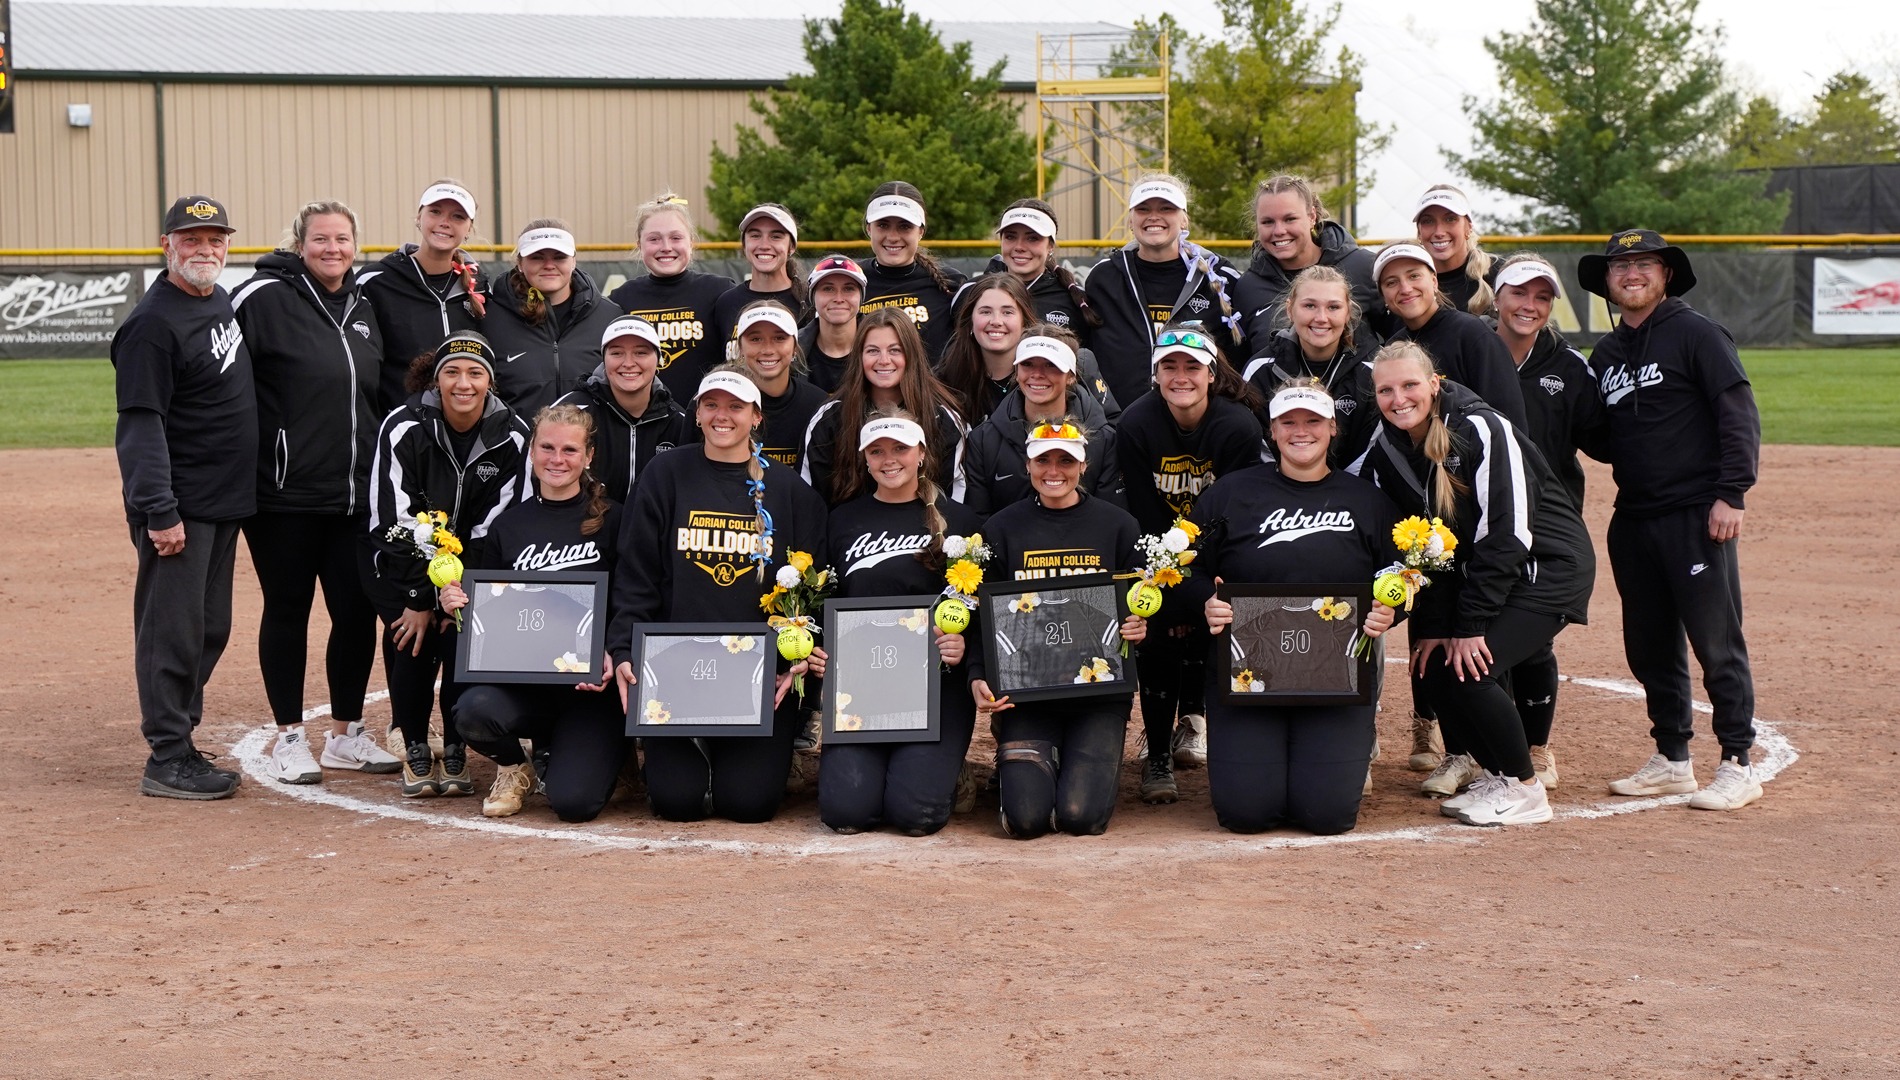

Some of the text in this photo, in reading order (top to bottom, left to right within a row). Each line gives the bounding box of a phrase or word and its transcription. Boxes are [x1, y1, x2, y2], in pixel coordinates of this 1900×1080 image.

[2, 271, 131, 330] Bianco
[661, 309, 695, 321] COLLEGE
[449, 346, 482, 356] SOFTBALL
[450, 341, 482, 350] BULLDOG
[692, 516, 757, 532] ADRIAN COLLE
[1259, 508, 1355, 534] Adrian
[513, 541, 600, 571] Adrian
[845, 531, 933, 562] Adrian
[1027, 555, 1101, 568] ADRIAN COLLEGE
[1136, 599, 1151, 611] 21
[1387, 588, 1402, 602] 50
[517, 608, 545, 631] 18
[942, 612, 966, 626] KIRA
[1045, 620, 1073, 645] 21
[1280, 629, 1311, 654] 50
[870, 645, 897, 668] 13
[690, 659, 717, 680] 44
